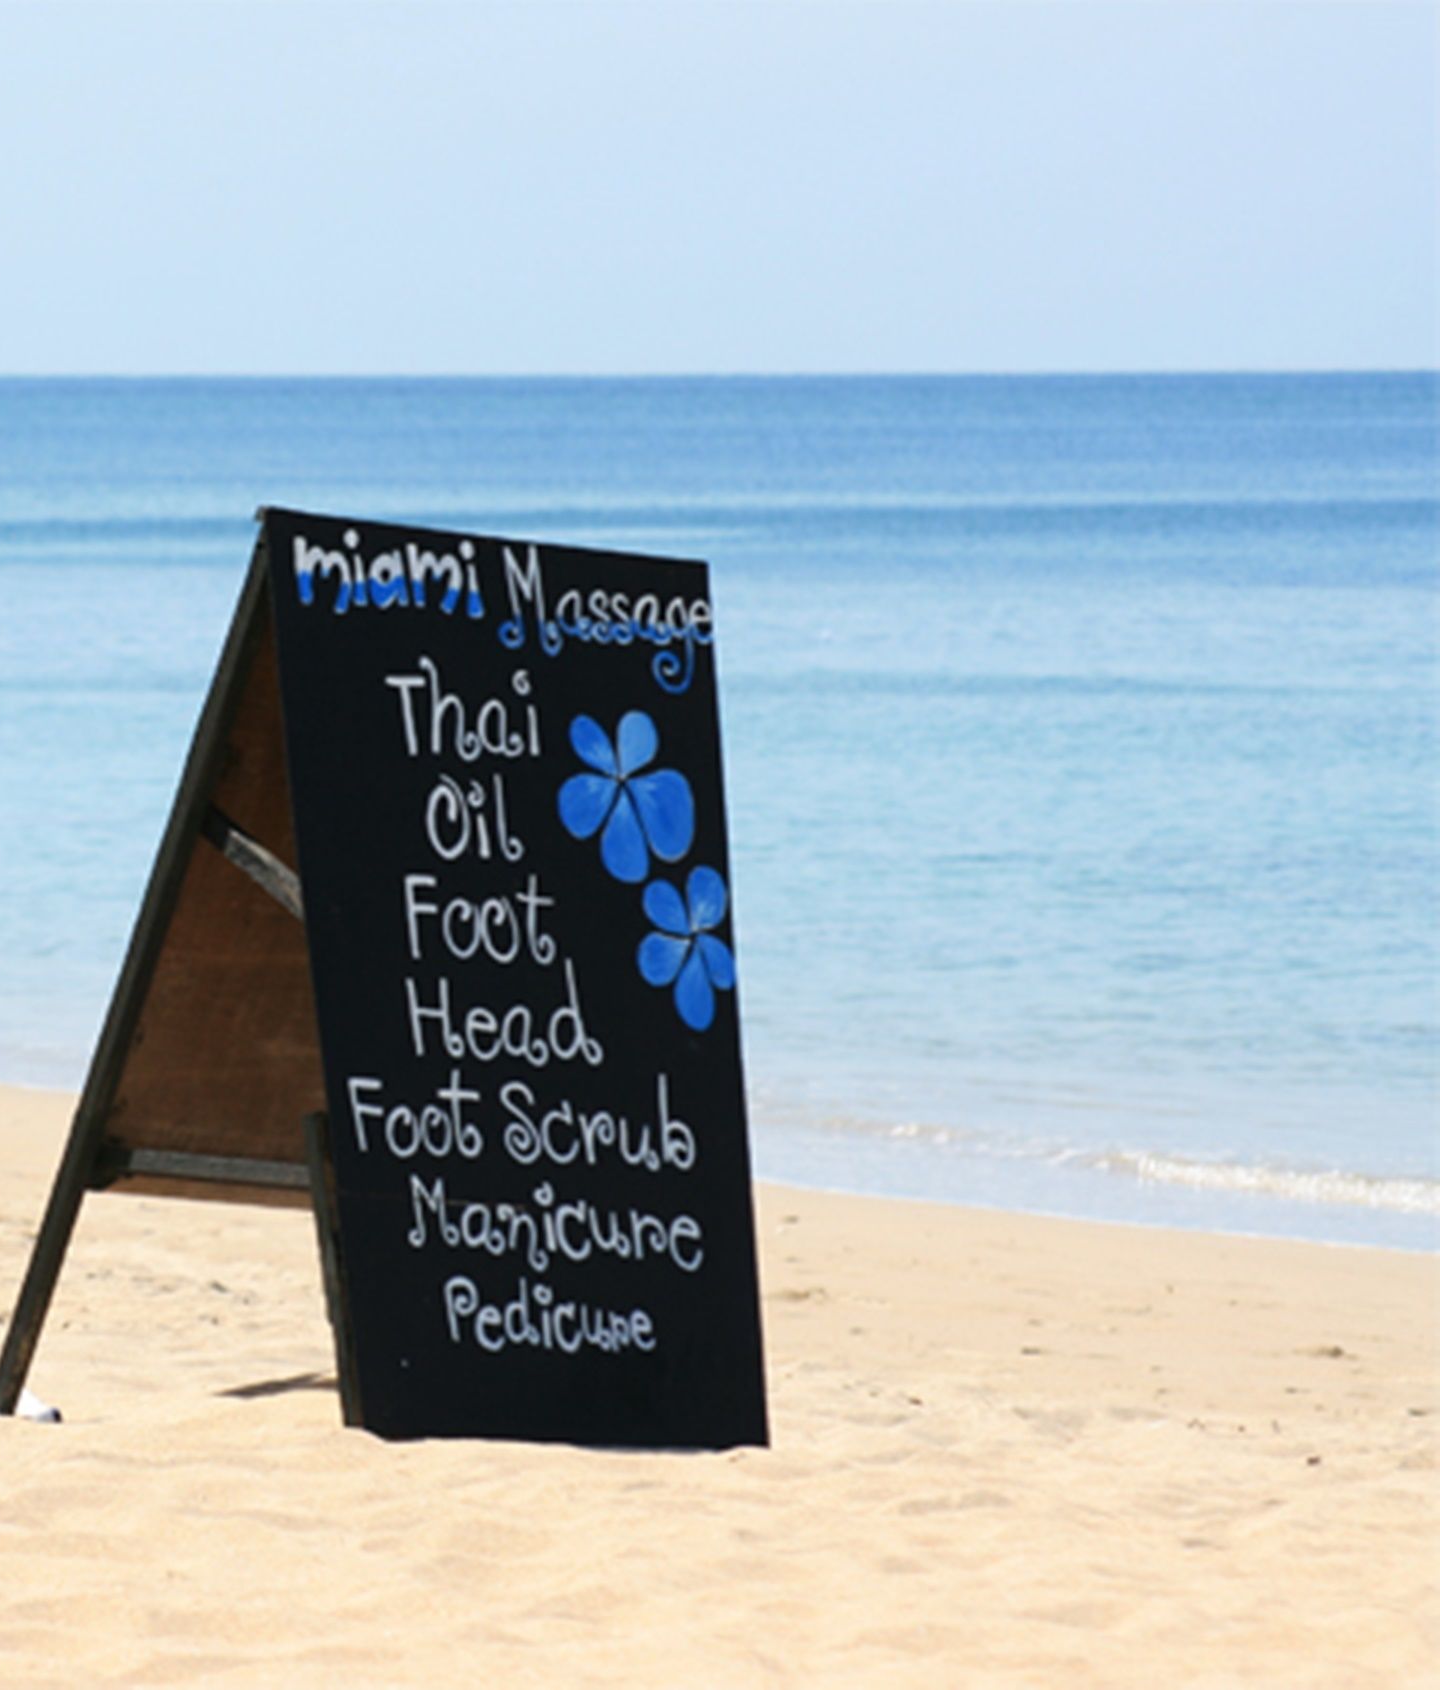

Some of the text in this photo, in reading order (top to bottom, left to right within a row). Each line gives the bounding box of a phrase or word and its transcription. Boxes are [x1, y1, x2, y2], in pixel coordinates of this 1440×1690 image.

[292, 528, 714, 693] miami Massage
[385, 656, 540, 762] Thai
[426, 774, 524, 861] Oil
[404, 874, 556, 965] Foot
[405, 958, 604, 1067] Head
[347, 1069, 696, 1171] Foot Scrub
[408, 1174, 705, 1272] Manicure
[443, 1276, 657, 1353] Pedicure
